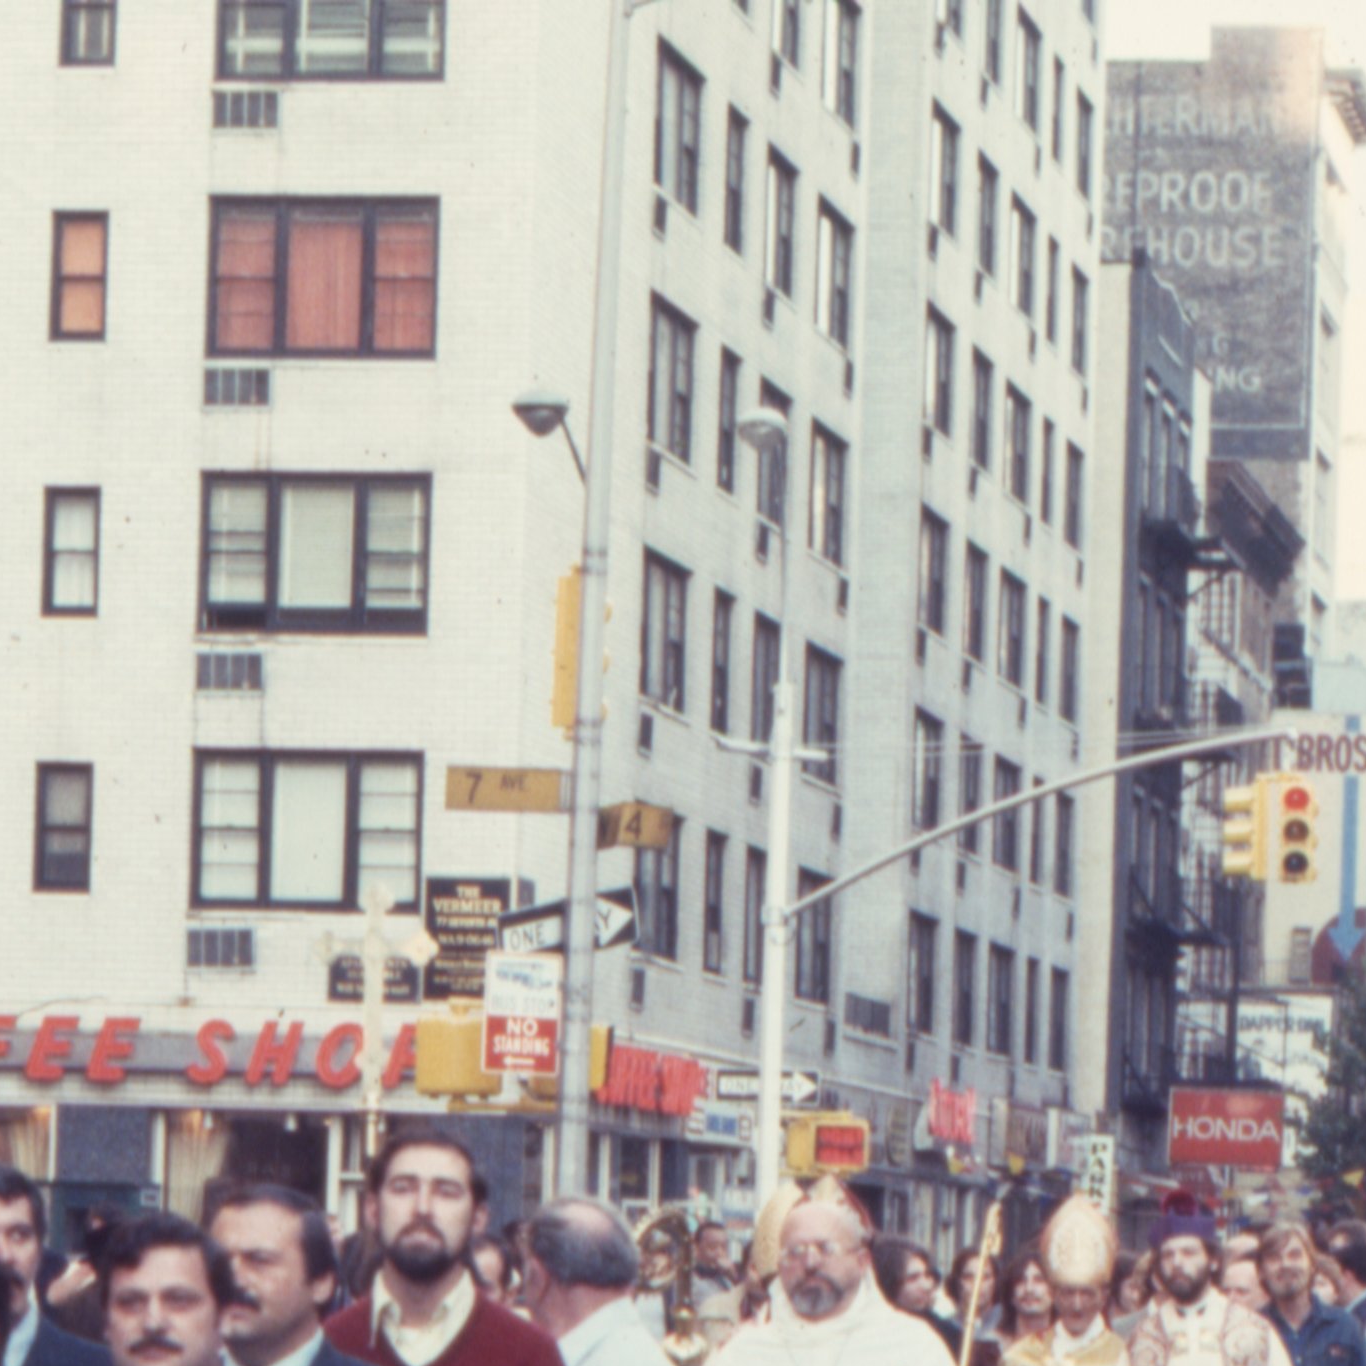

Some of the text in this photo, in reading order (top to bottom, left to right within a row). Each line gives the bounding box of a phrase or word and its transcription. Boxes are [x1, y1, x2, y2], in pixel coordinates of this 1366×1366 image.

[465, 770, 483, 805] 7
[457, 884, 481, 899] THE
[432, 896, 502, 914] VERMEER
[509, 920, 545, 950] ONE
[506, 1016, 540, 1039] NO
[493, 1035, 551, 1057] STANDING
[1171, 1115, 1281, 1143] HONDA
